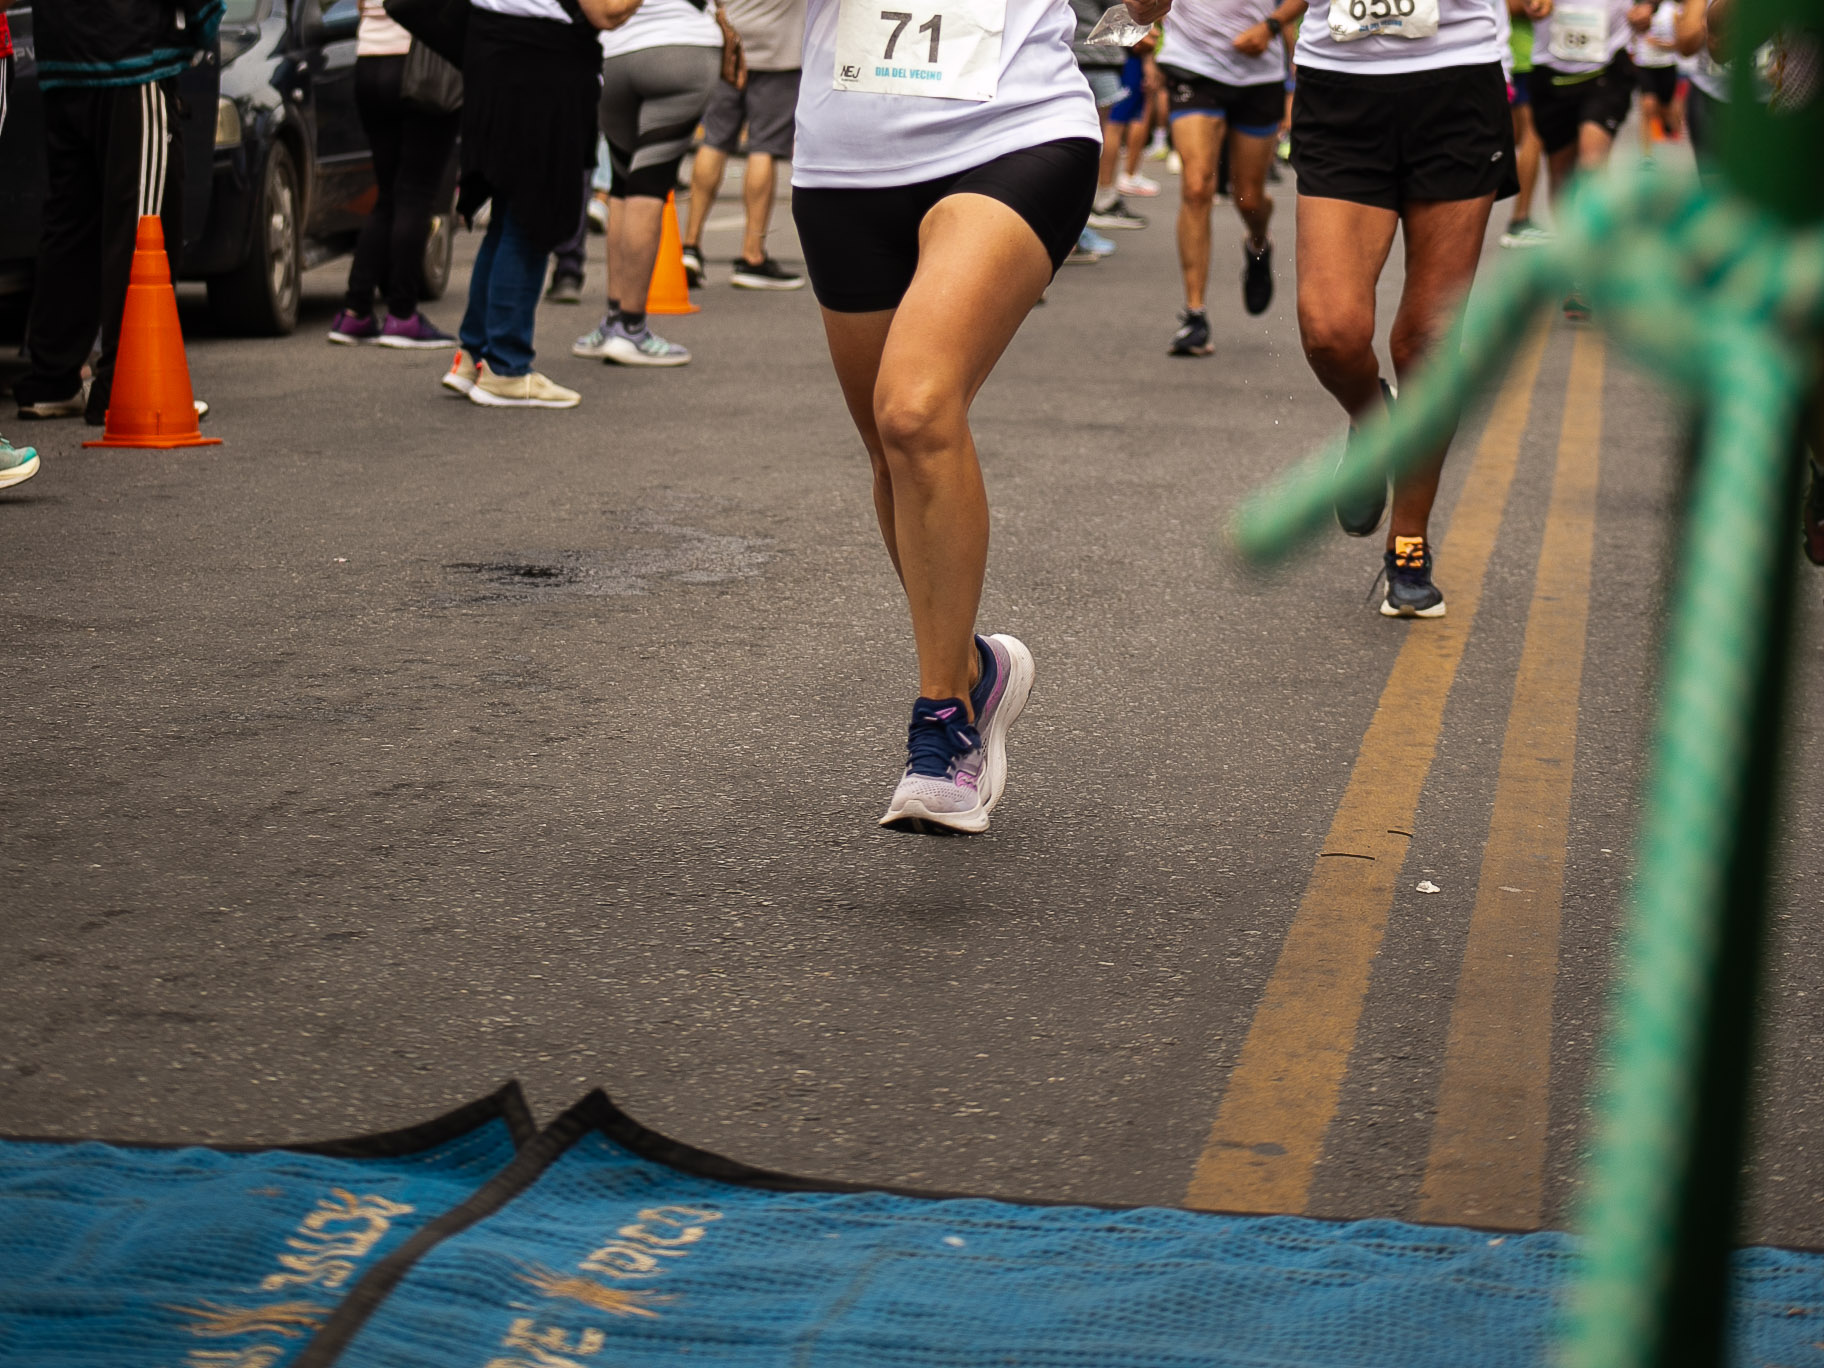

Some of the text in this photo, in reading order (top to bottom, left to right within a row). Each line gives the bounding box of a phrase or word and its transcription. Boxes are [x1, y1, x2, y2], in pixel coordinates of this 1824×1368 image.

[881, 10, 942, 63] 71
[840, 65, 861, 79] NEJ
[875, 67, 942, 81] DIA DEL VECINO
